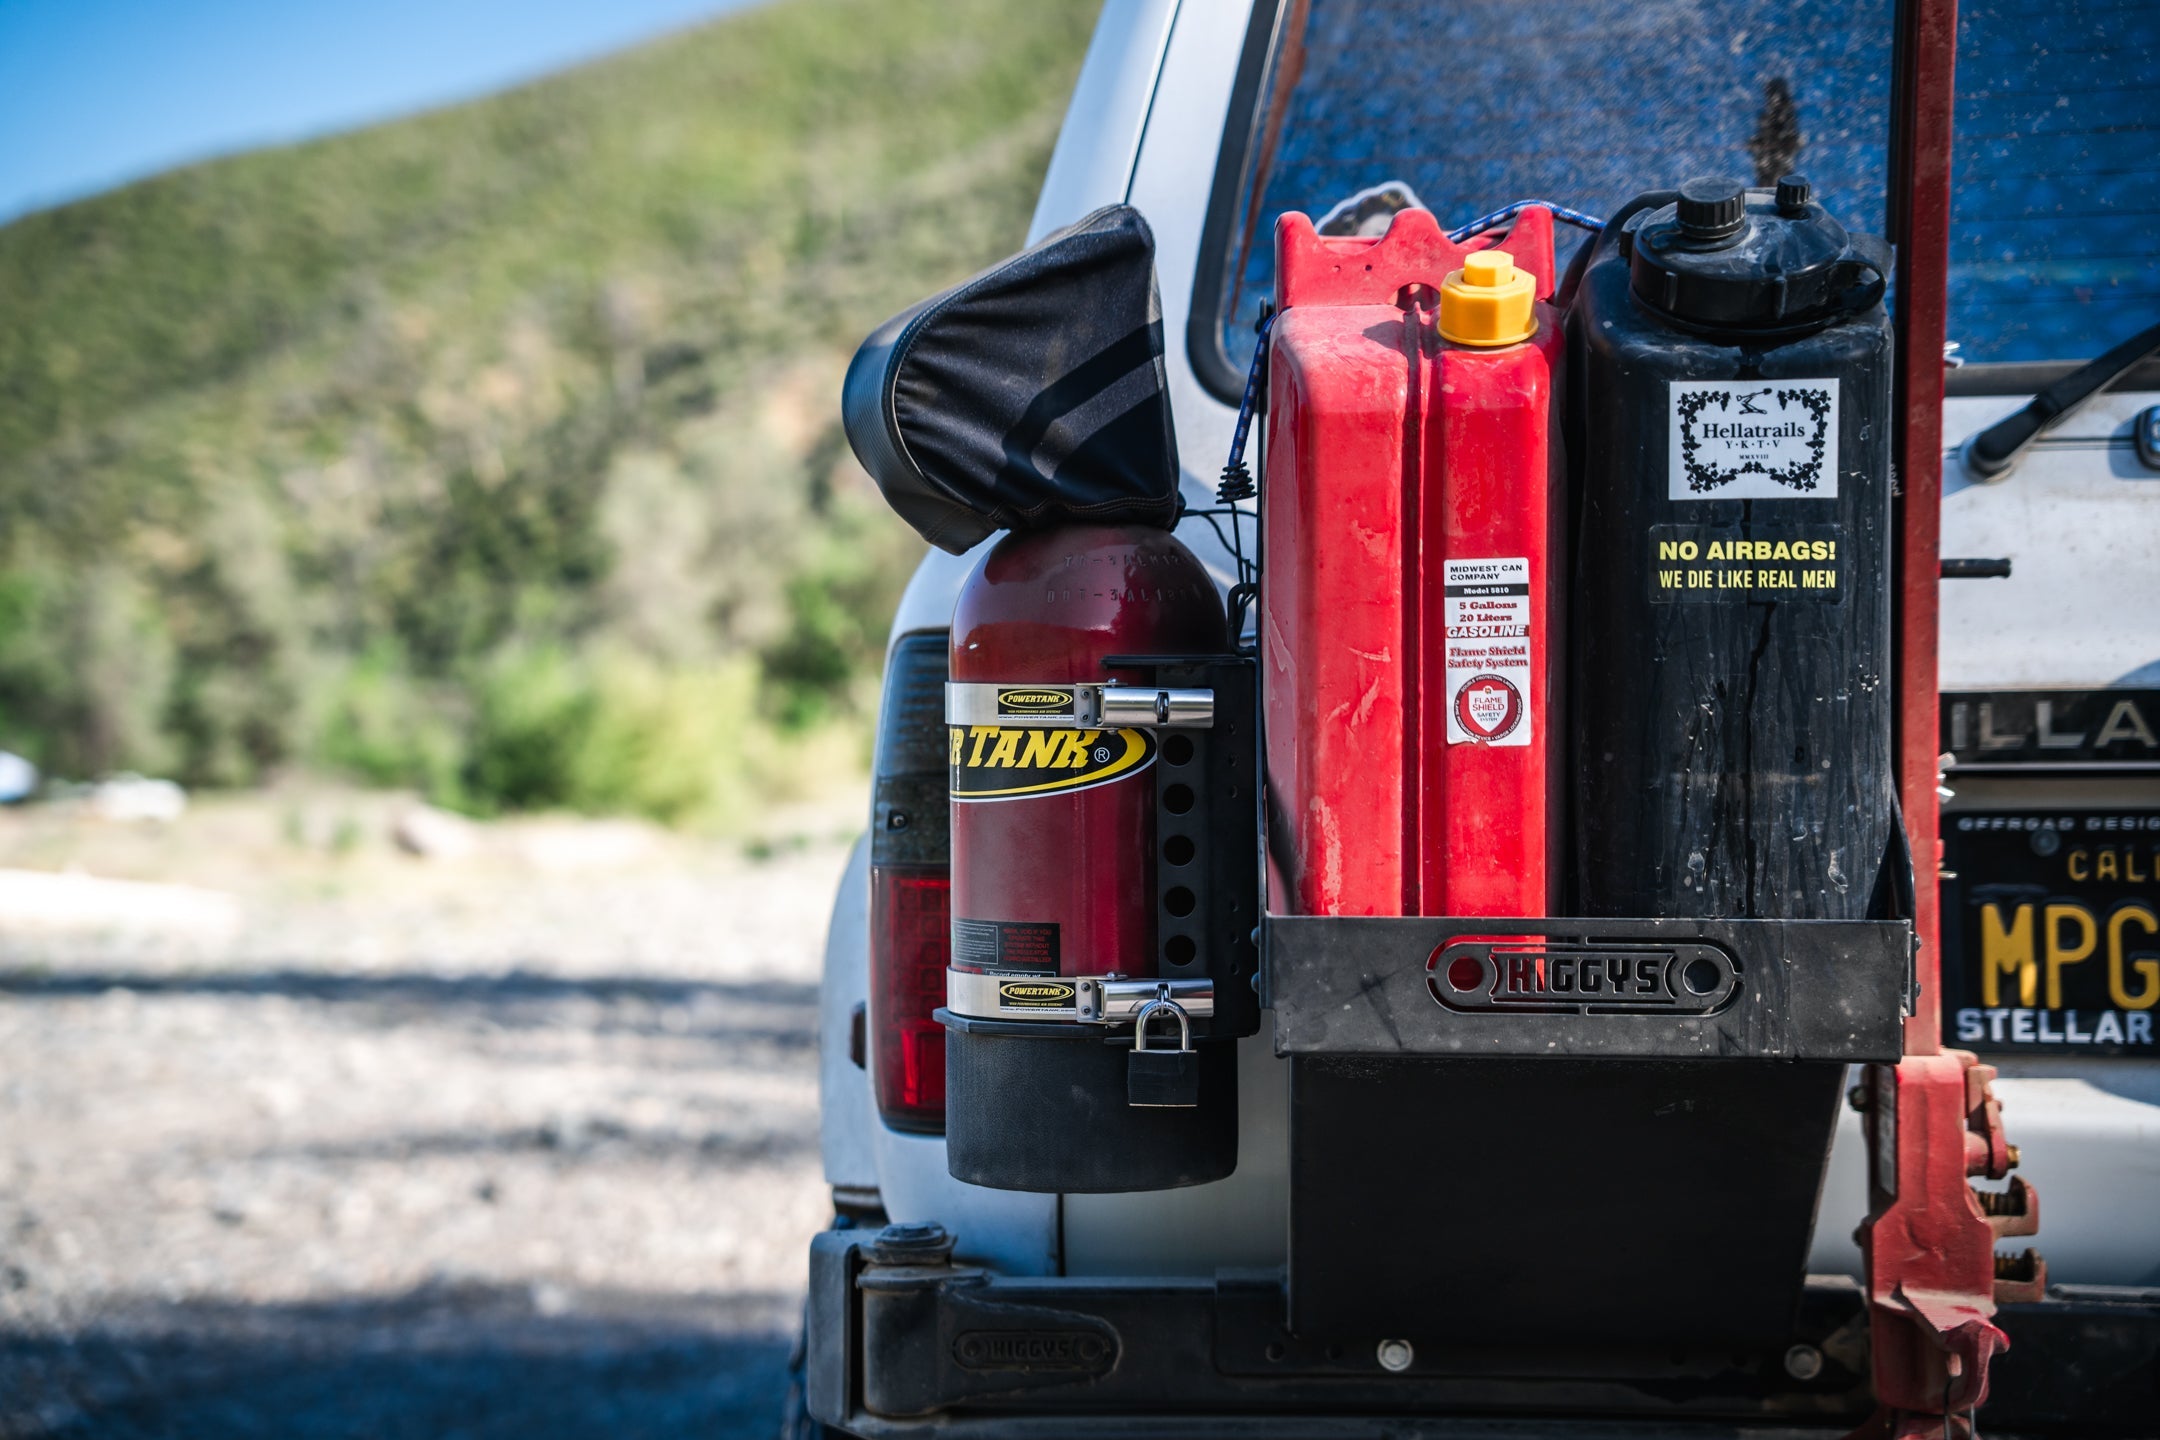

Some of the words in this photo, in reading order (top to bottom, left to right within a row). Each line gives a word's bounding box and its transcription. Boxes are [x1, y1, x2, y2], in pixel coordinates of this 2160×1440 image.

[1702, 422, 1805, 438] Hellatrails
[1659, 541, 1699, 561] NO
[1706, 541, 1836, 561] AIRBAGS!
[1450, 565, 1498, 573] MIDWEST
[1450, 573, 1500, 581] COMPANY
[1659, 570, 1683, 588] WE
[1688, 570, 1713, 588] DIE
[1718, 570, 1753, 588] LIKE
[1758, 570, 1797, 588] REAL
[1802, 570, 1836, 588] MEN
[1463, 587, 1489, 595] Model
[1459, 602, 1466, 610] 5
[1470, 601, 1518, 610] Gallons
[1460, 614, 1474, 623] 20
[1477, 613, 1512, 622] Liters
[1446, 625, 1526, 638] GASOLINE
[1449, 647, 1487, 657] Flame
[1489, 646, 1526, 656] Shield
[1448, 659, 1484, 670] Safety
[1486, 658, 1528, 670] System
[1007, 695, 1060, 703] POWERTANK
[1472, 704, 1504, 712] SHIELD
[1958, 817, 2075, 831] OFFROAD
[1981, 903, 2160, 1010] MPG
[1507, 957, 1659, 994] HIGGYS
[1008, 987, 1061, 996] POWERTANK
[1956, 1008, 2154, 1044] STELLAR
[991, 1339, 1070, 1360] HIGGYS
